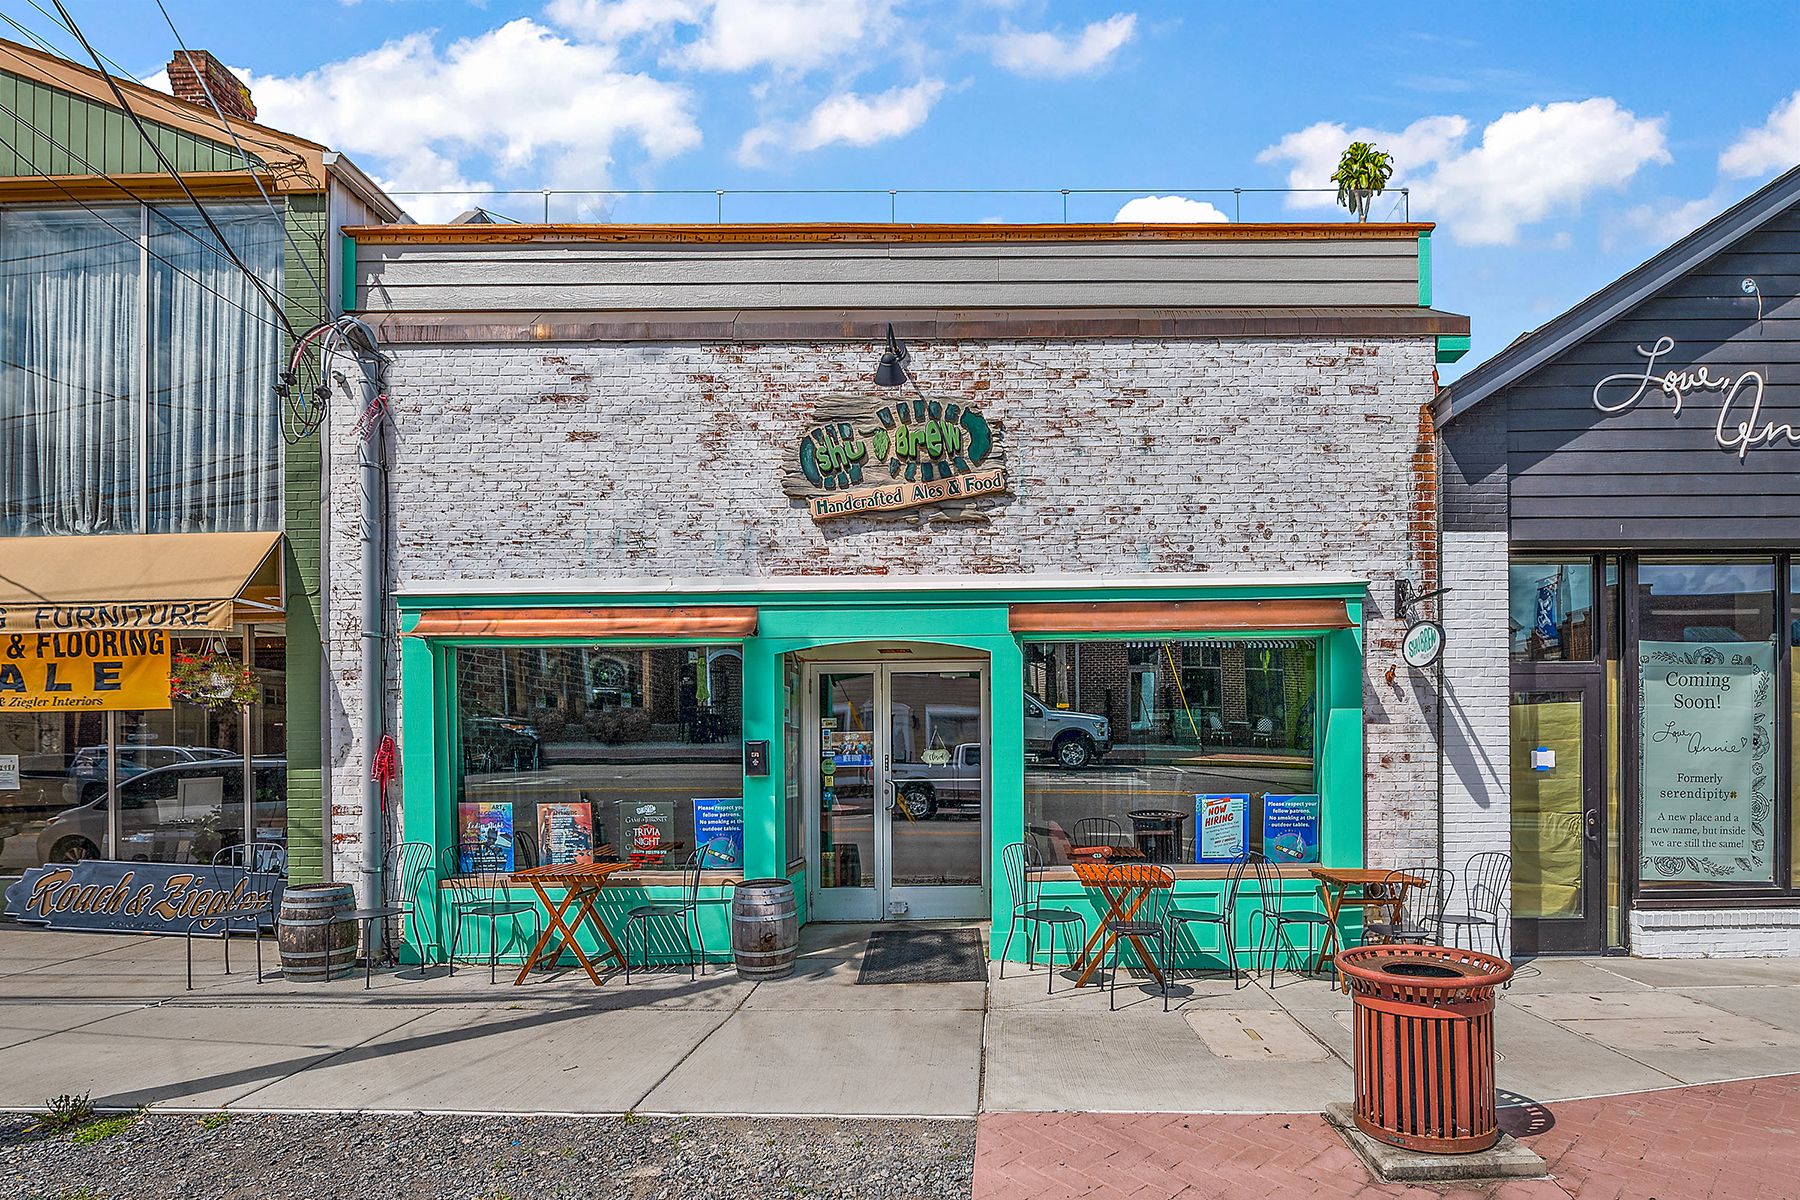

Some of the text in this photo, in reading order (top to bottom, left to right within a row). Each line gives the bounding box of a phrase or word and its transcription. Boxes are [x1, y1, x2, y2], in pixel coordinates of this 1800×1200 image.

[815, 471, 1004, 516] Handcrafted Ales & Food
[35, 604, 210, 628] FURNITURE
[7, 629, 165, 658] & FLOORING
[1665, 671, 1731, 691] Coming
[8, 696, 50, 709] Ziegler
[52, 695, 104, 707] Interiors
[1673, 693, 1721, 709] Soon!
[1687, 731, 1741, 755] Annie
[1677, 773, 1723, 785] Formerly
[1659, 788, 1730, 801] serendipity
[1208, 804, 1228, 816] NOW
[1205, 812, 1234, 827] HIRING
[1657, 812, 1666, 821] A
[1689, 813, 1713, 823] place
[1714, 813, 1731, 822] and
[632, 827, 661, 837] TRIVIA
[1702, 826, 1717, 835] but
[1720, 826, 1746, 835] inside
[633, 837, 661, 846] NIGHT
[1684, 839, 1700, 847] still
[1702, 839, 1717, 847] the
[1719, 839, 1744, 848] same!
[25, 867, 137, 919] Roach
[124, 883, 155, 917] &
